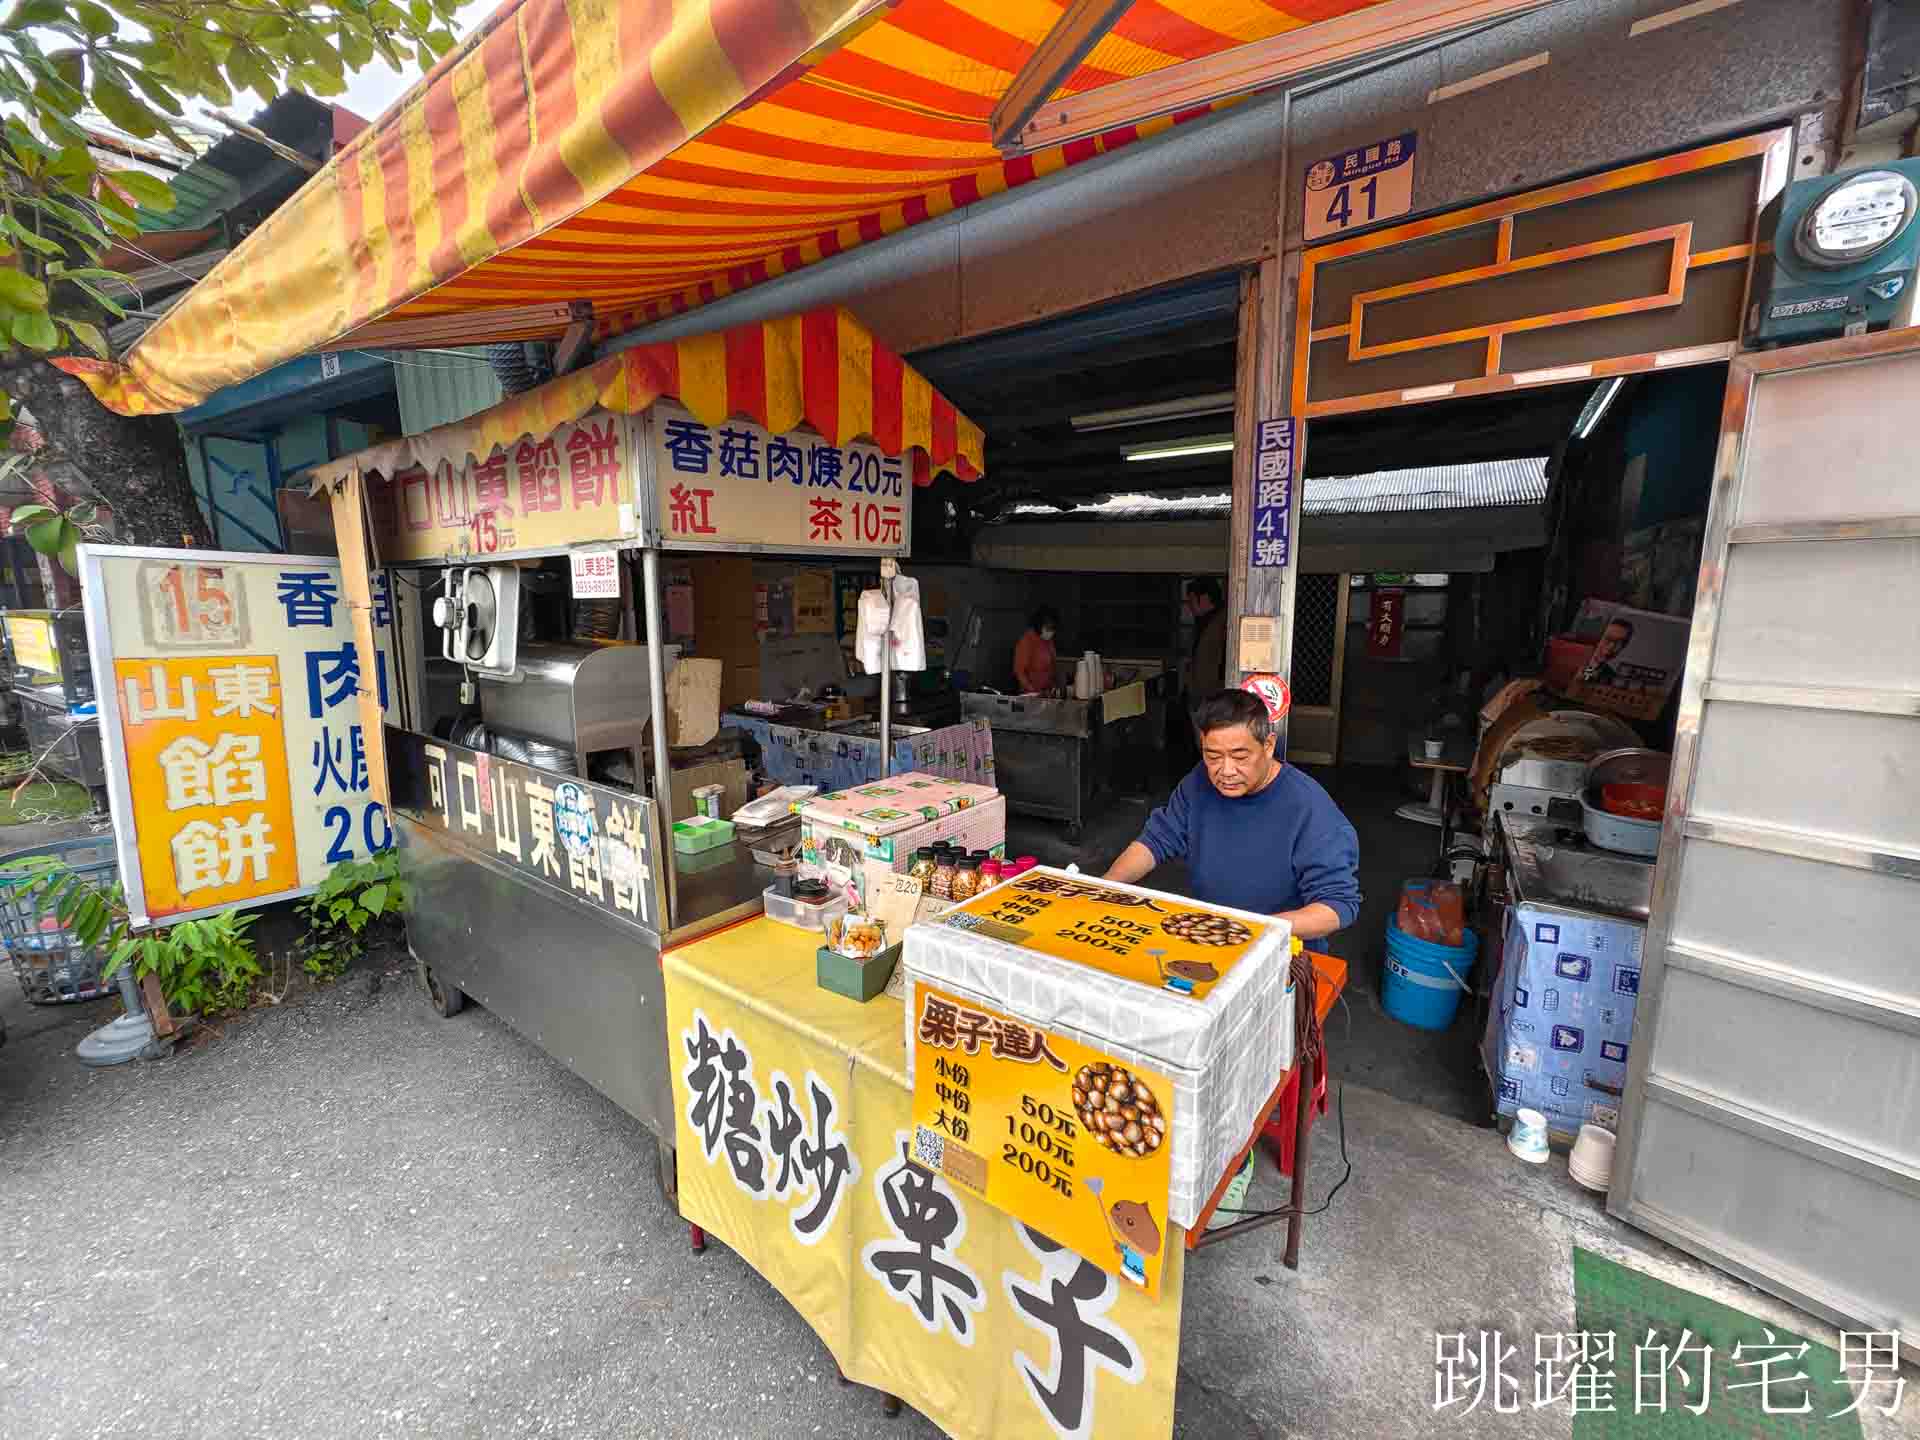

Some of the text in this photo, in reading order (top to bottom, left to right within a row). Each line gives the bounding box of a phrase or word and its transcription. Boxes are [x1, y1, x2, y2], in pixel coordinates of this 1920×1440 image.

[1344, 140, 1401, 170] 民國路
[1326, 175, 1378, 227] 41
[362, 420, 621, 530] 口山東餡餅
[1255, 420, 1292, 566] 民國路41號
[669, 482, 901, 545] 紅 茶10元
[471, 512, 517, 554] 15元
[575, 556, 615, 577] 山東餡餅
[159, 564, 233, 632] 15
[1000, 901, 1039, 916] 中份
[1012, 876, 1166, 913] 栗子達人
[1014, 894, 1051, 907] 小份
[981, 909, 1024, 924] 大份
[1074, 920, 1142, 945] 100元
[1100, 915, 1152, 936] 50元
[1056, 929, 1130, 956] 200元
[918, 994, 1068, 1072] 栗子達人
[934, 1056, 969, 1087] 小份
[935, 1082, 970, 1114] 中份
[933, 1109, 969, 1142] 大份
[1021, 1094, 1076, 1139] 50元
[1006, 1115, 1074, 1168] 100元
[1003, 1143, 1073, 1199] 200元
